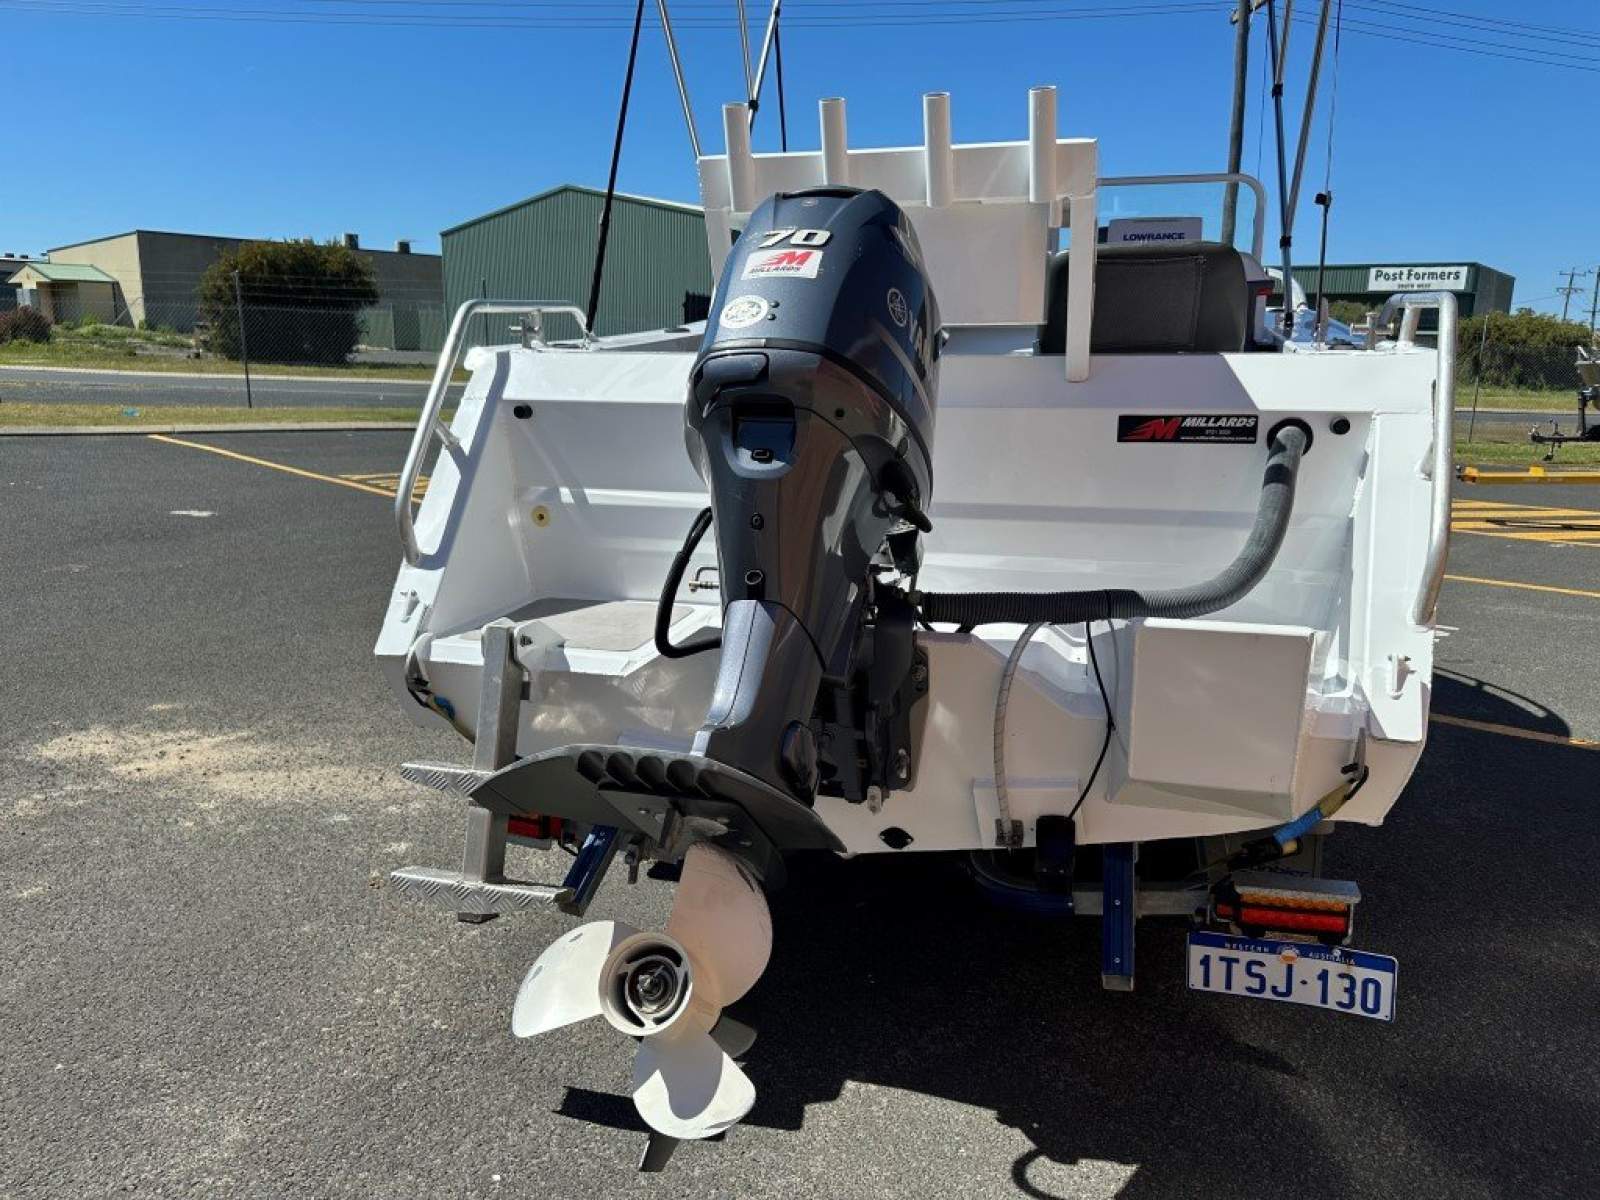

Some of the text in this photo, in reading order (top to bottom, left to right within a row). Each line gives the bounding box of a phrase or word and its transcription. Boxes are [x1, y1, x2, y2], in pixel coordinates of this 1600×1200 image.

[758, 229, 831, 248] 70
[1122, 232, 1186, 242] LOWRANCE
[1374, 268, 1462, 281] Post Formers
[1181, 416, 1258, 428] MILLARDS
